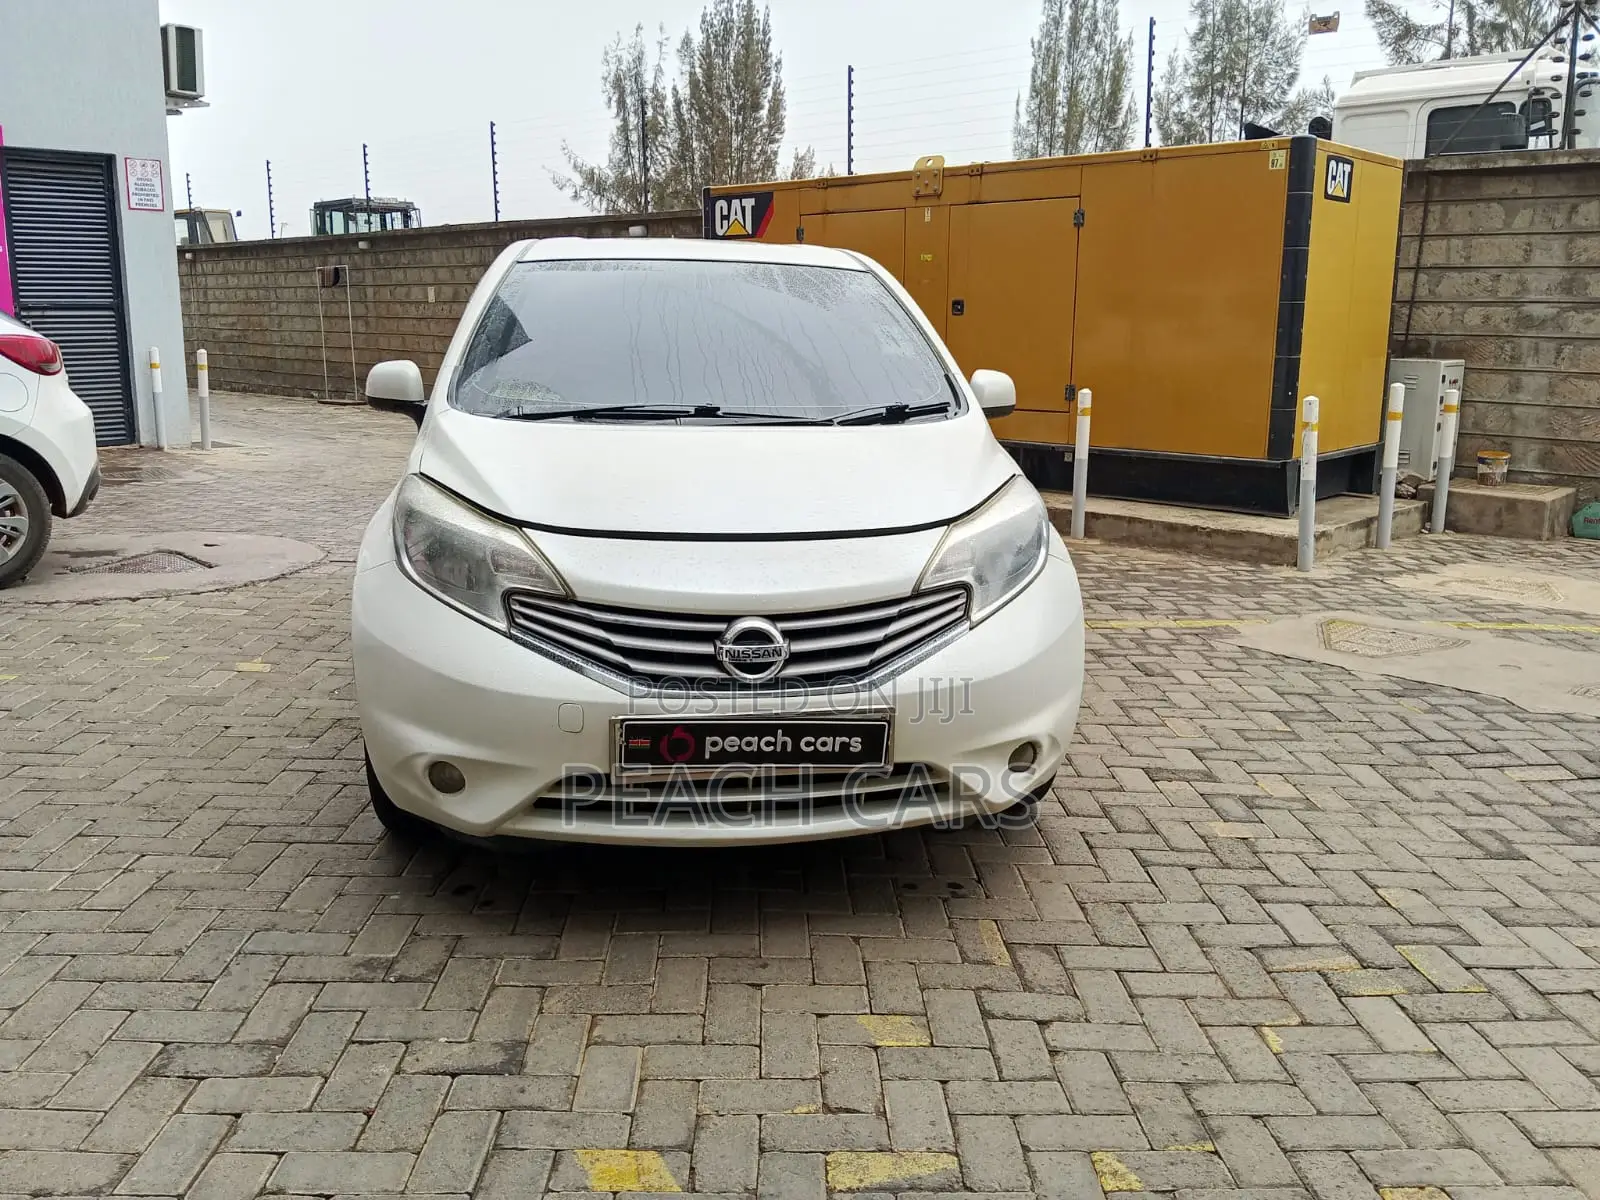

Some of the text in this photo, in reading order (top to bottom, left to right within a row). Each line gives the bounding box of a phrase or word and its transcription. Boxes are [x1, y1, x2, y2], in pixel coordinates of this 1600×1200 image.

[1327, 160, 1351, 198] CAT
[715, 198, 755, 236] CAT
[725, 648, 782, 659] NISSAN
[704, 729, 862, 760] peach cars
